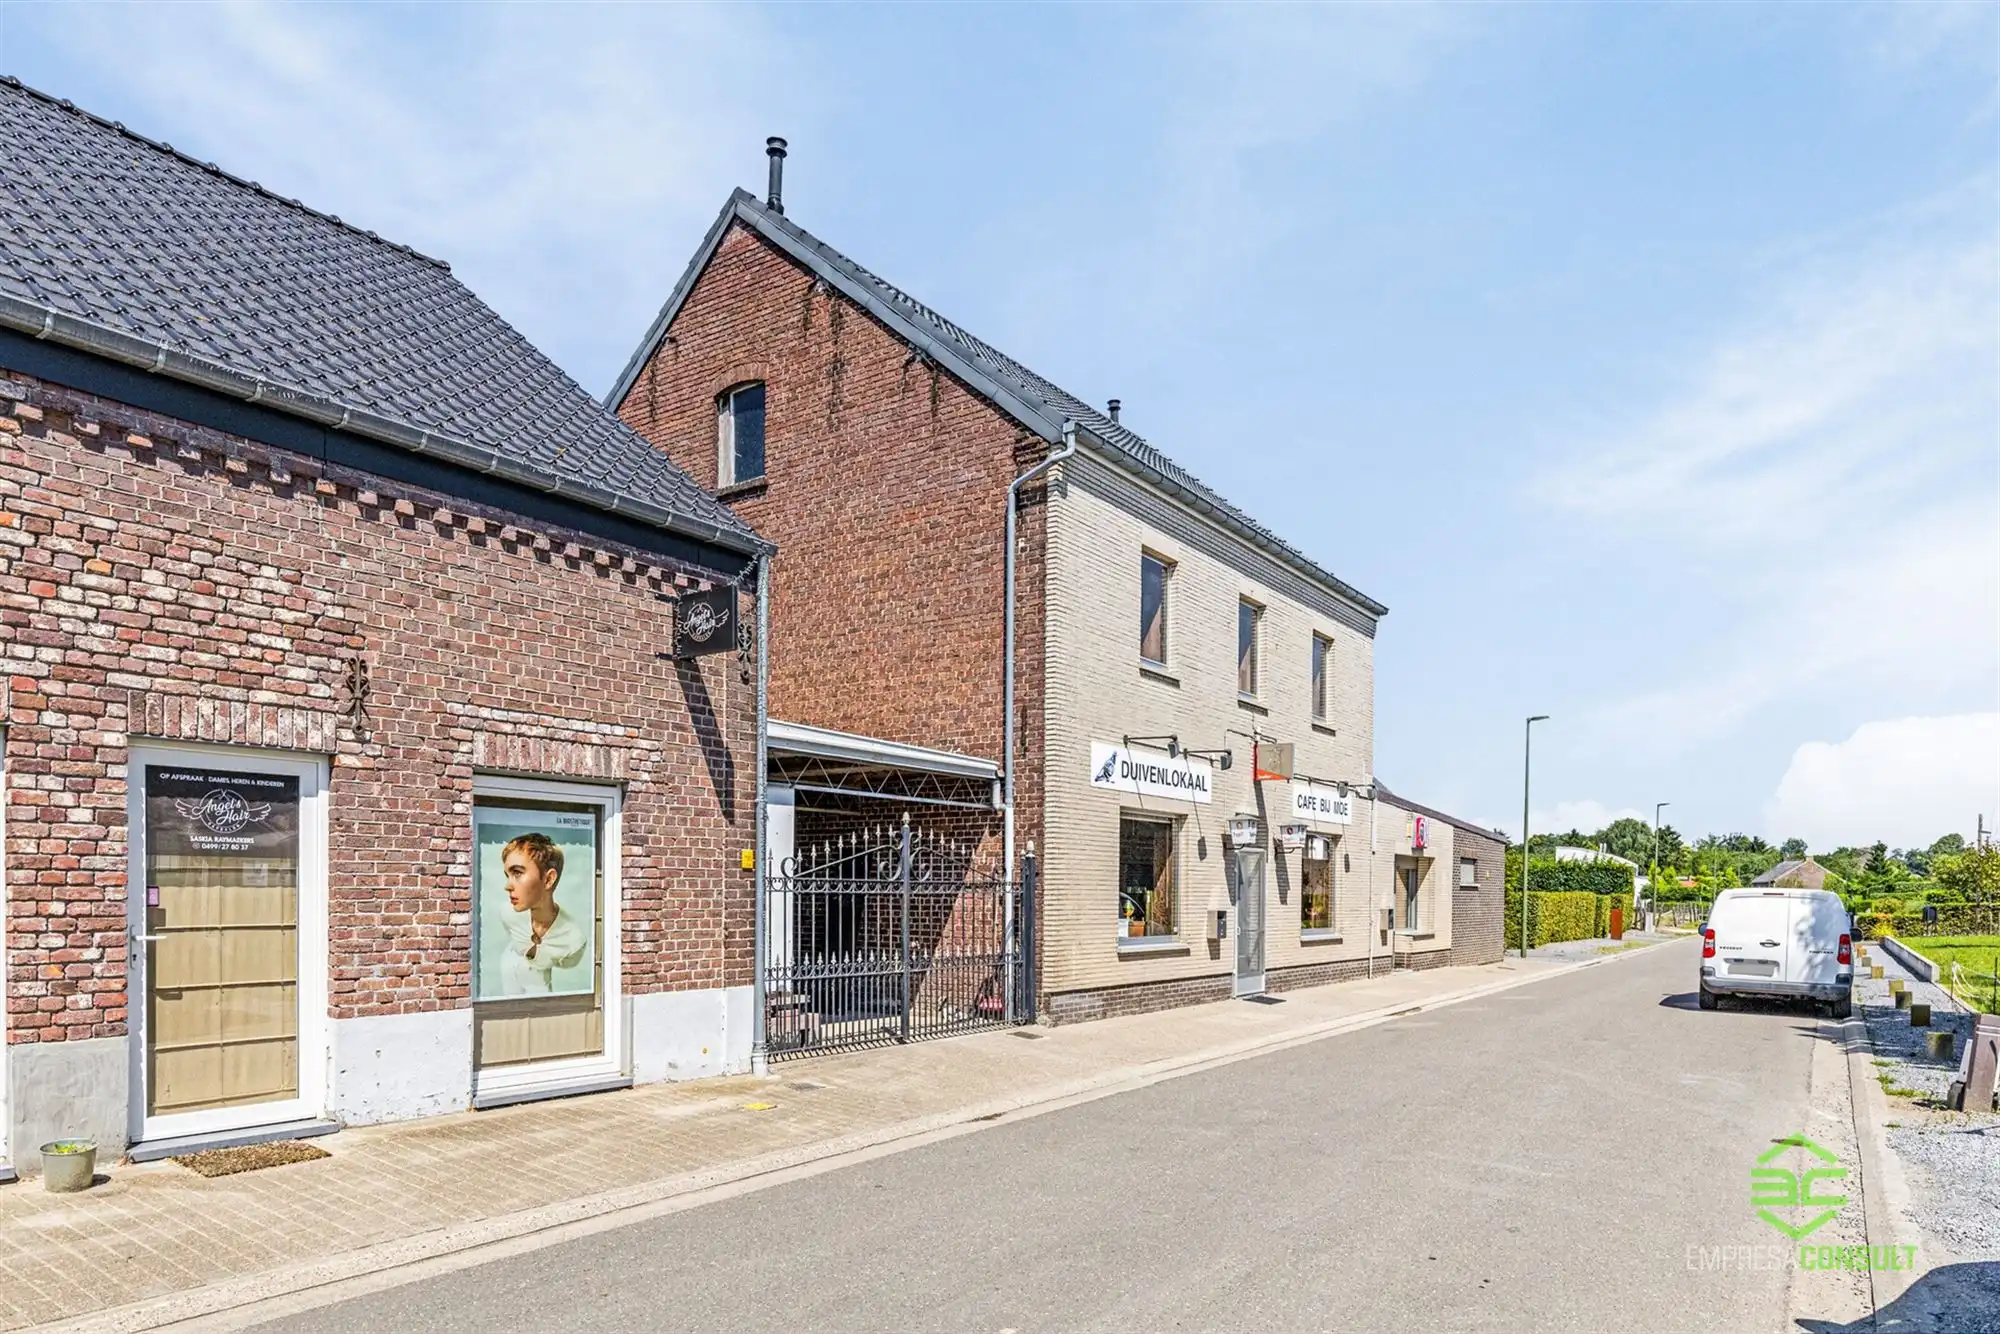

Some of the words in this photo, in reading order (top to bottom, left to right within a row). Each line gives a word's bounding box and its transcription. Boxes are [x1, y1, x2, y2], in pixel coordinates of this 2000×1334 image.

[171, 774, 204, 782] AFSPRAAK
[257, 780, 285, 788] KINDEREN
[1121, 760, 1208, 792] DUIVENLOKAAL
[192, 798, 241, 815] Angel's
[1297, 794, 1317, 811] CAFE
[1320, 798, 1331, 813] BIJ
[1333, 800, 1348, 816] MOE
[216, 810, 250, 825] Hair
